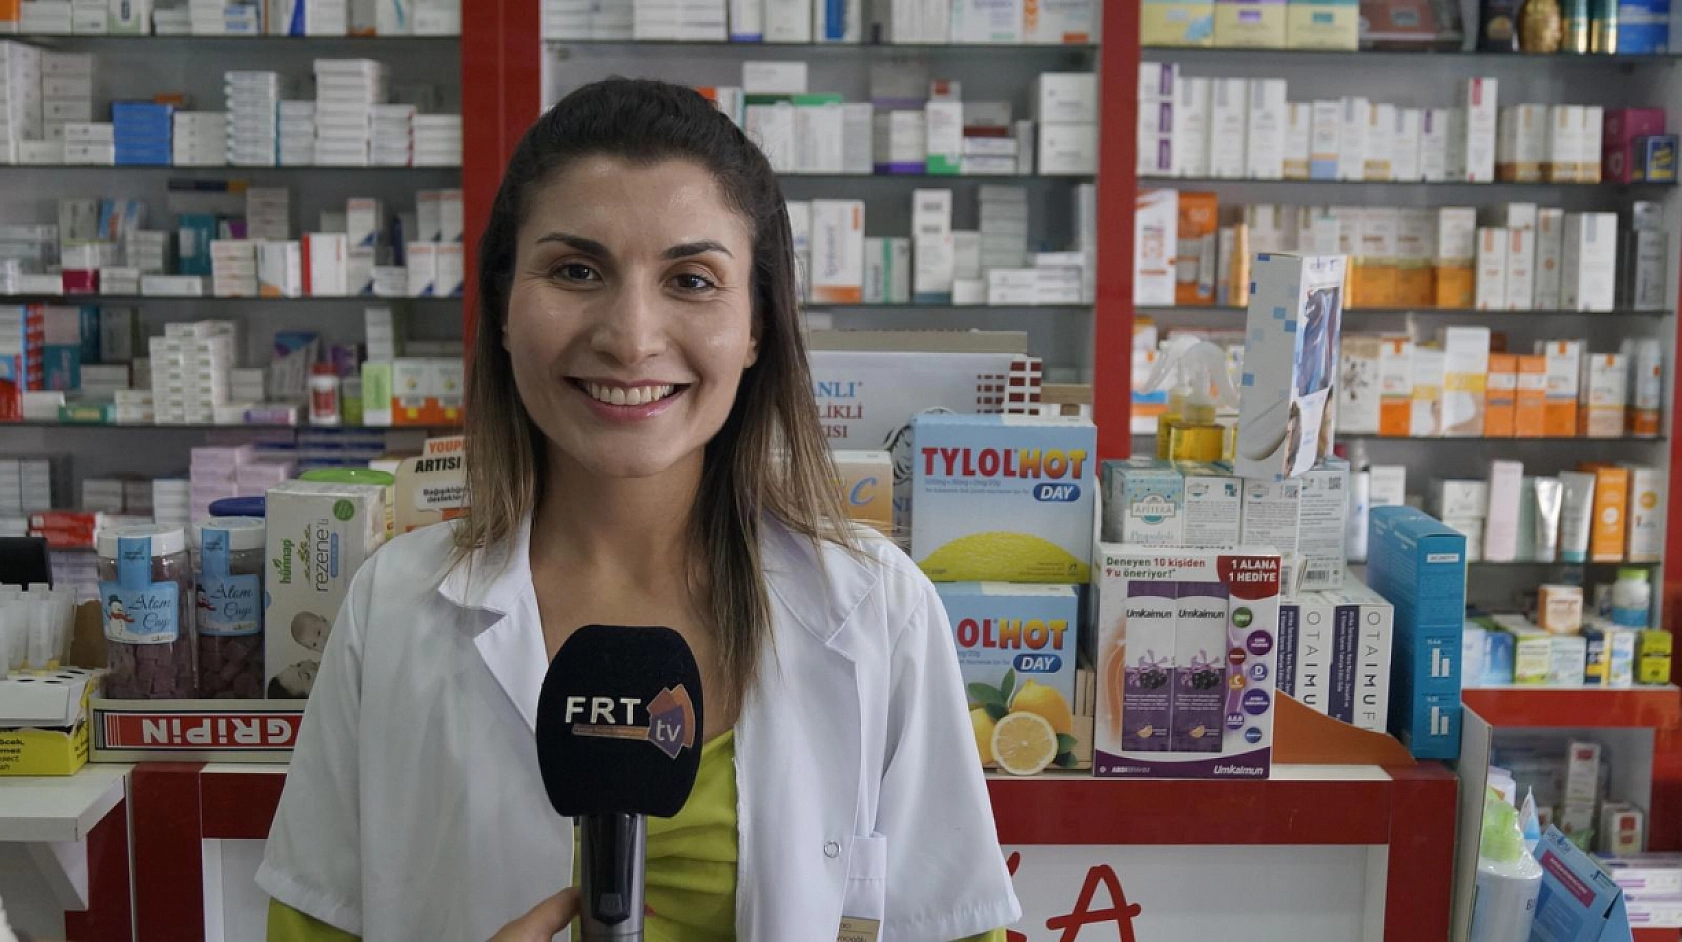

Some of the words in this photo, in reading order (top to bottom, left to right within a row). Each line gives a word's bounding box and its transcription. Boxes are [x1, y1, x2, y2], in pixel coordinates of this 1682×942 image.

[814, 381, 856, 397] NLI
[429, 440, 466, 453] YOUP
[415, 456, 461, 473] ARTISI
[921, 448, 1088, 480] TYLOLHOT
[849, 477, 877, 506] C
[1040, 485, 1075, 500] DAY
[1106, 556, 1151, 568] Deneyen
[1154, 556, 1166, 567] 10
[1231, 559, 1237, 570] 1
[1240, 559, 1277, 570] ALANA
[1229, 572, 1234, 582] 1
[957, 617, 1069, 651] OLHOT
[1021, 656, 1055, 671] DAY
[1302, 610, 1321, 705] OTAIMU
[1362, 610, 1382, 731] OTAIMUF
[565, 695, 642, 726] FRT
[655, 718, 682, 742] tv
